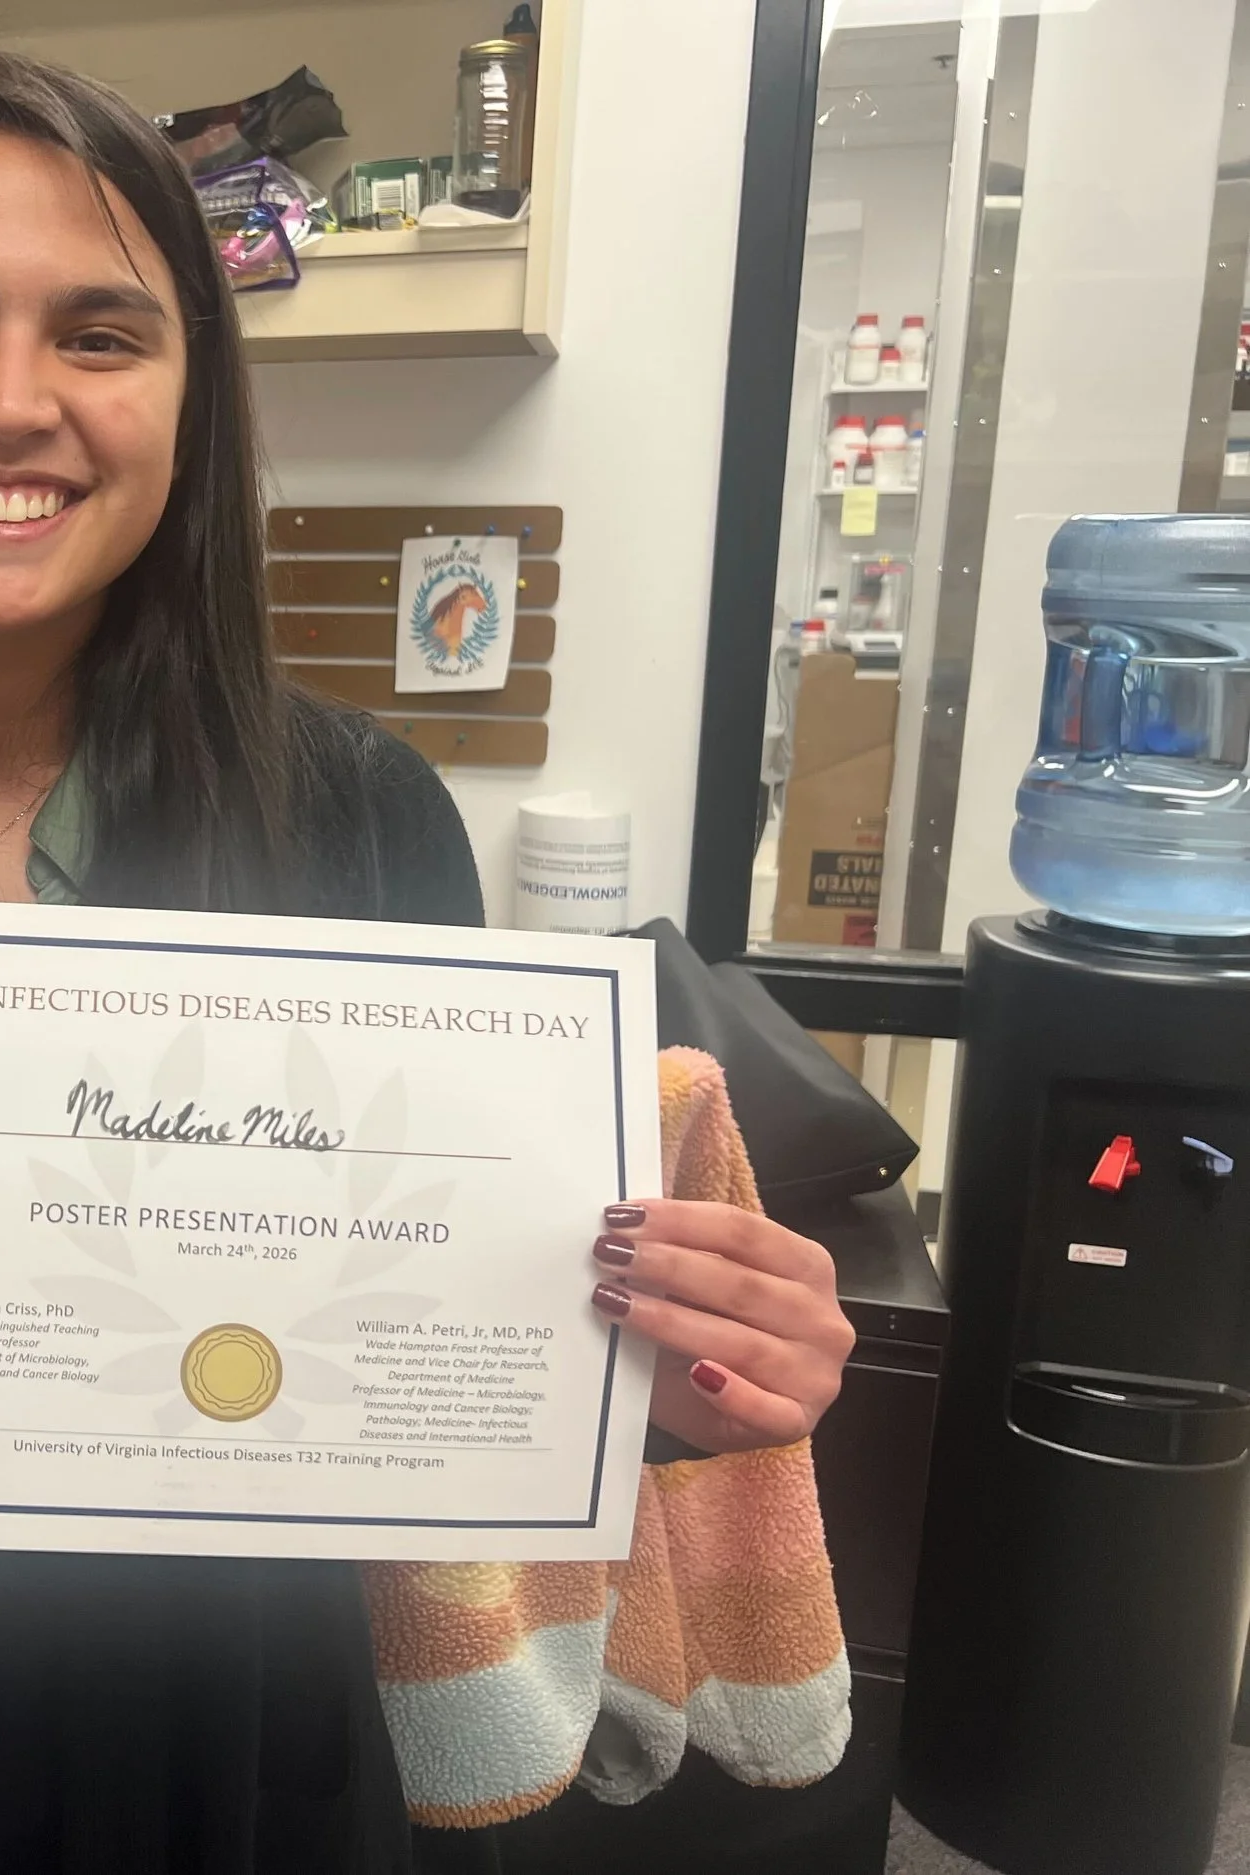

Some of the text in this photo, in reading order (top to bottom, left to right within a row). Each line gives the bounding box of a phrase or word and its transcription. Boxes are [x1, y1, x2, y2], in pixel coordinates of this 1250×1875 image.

[179, 994, 331, 1025] DISEASES
[341, 1002, 512, 1034] RESEARCH
[522, 1013, 589, 1039] DAY
[66, 1078, 345, 1152] Madeline Miles
[29, 1202, 450, 1244] POSTER PRESENTATION AWARD
[177, 1242, 297, 1260] March 24th, 2026
[5, 1302, 41, 1317] Criss,
[46, 1304, 74, 1317] PhD
[53, 1323, 100, 1337] Teaching
[356, 1320, 554, 1340] William A. Petri, Jr, MD, PhD
[365, 1339, 544, 1357] Wade Hampton Frost Professor of
[5, 1352, 16, 1364] of
[18, 1353, 89, 1367] Microbiology,
[354, 1354, 402, 1365] Medicine
[405, 1356, 425, 1366] and
[428, 1358, 450, 1368] Vice
[452, 1358, 480, 1369] Chair
[481, 1358, 498, 1371] for
[0, 1368, 20, 1379] and
[22, 1368, 59, 1380] Cancer
[61, 1370, 100, 1383] Biology
[388, 1370, 515, 1385] Department of Medicine
[352, 1384, 401, 1397] Professor
[404, 1385, 416, 1397] of
[417, 1386, 465, 1398] Medicine
[363, 1400, 428, 1413] Immunology
[431, 1403, 451, 1413] and
[454, 1404, 490, 1414] Cancer
[478, 1418, 528, 1430] Infectious
[359, 1429, 532, 1444] Diseases and International Health
[14, 1439, 445, 1470] University of Virginia Infectious Diseases T32 Training Program
